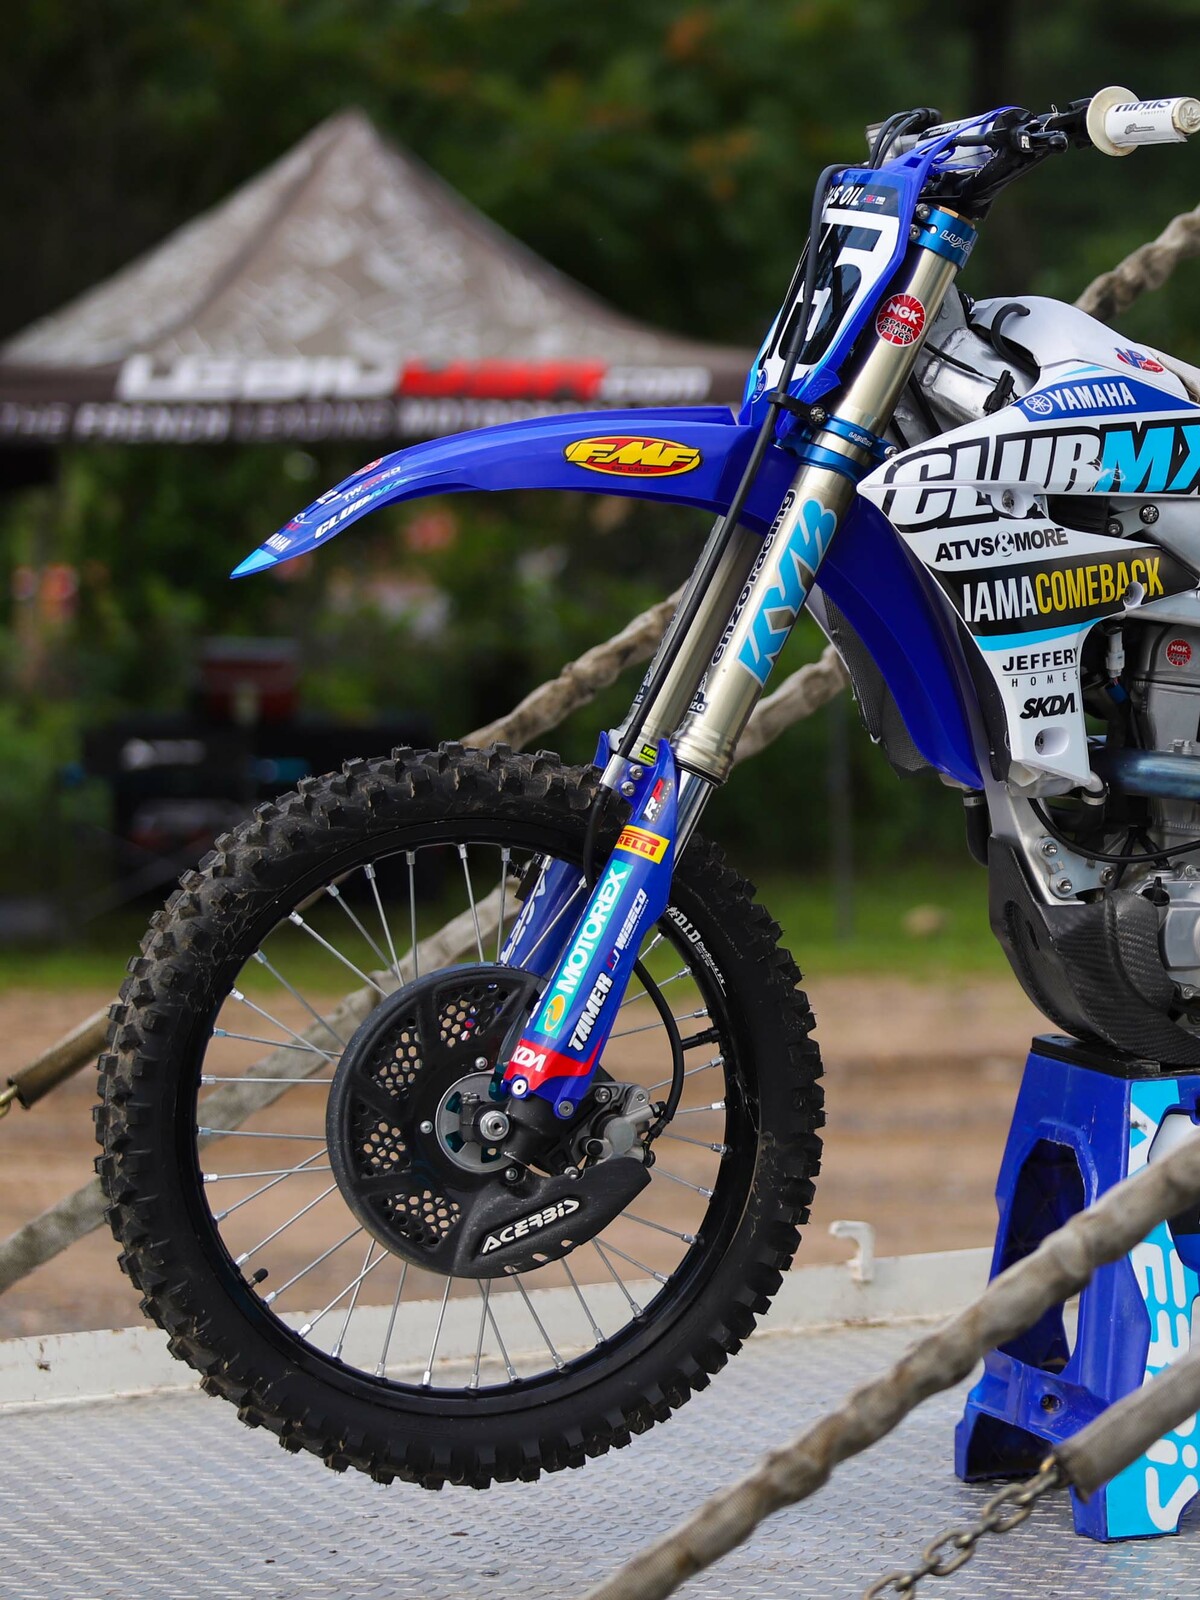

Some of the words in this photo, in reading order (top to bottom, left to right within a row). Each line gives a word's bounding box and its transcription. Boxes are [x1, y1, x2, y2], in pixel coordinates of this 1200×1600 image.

[840, 185, 865, 206] OIL
[939, 229, 972, 253] LUXO
[883, 316, 914, 335] SPARK
[886, 301, 921, 325] NGK
[880, 323, 911, 342] PLUGS
[1114, 347, 1147, 369] VP
[1046, 382, 1137, 411] YAMAHA
[566, 440, 700, 467] FMF
[935, 527, 1069, 562] ATVS&MORE
[711, 584, 751, 666] enzo
[748, 489, 797, 583] racing
[1170, 644, 1188, 654] NGK
[618, 831, 660, 857] RELLI
[555, 866, 628, 995] MOTOREX
[568, 971, 614, 1052] TAMER
[511, 1044, 547, 1073] KDA
